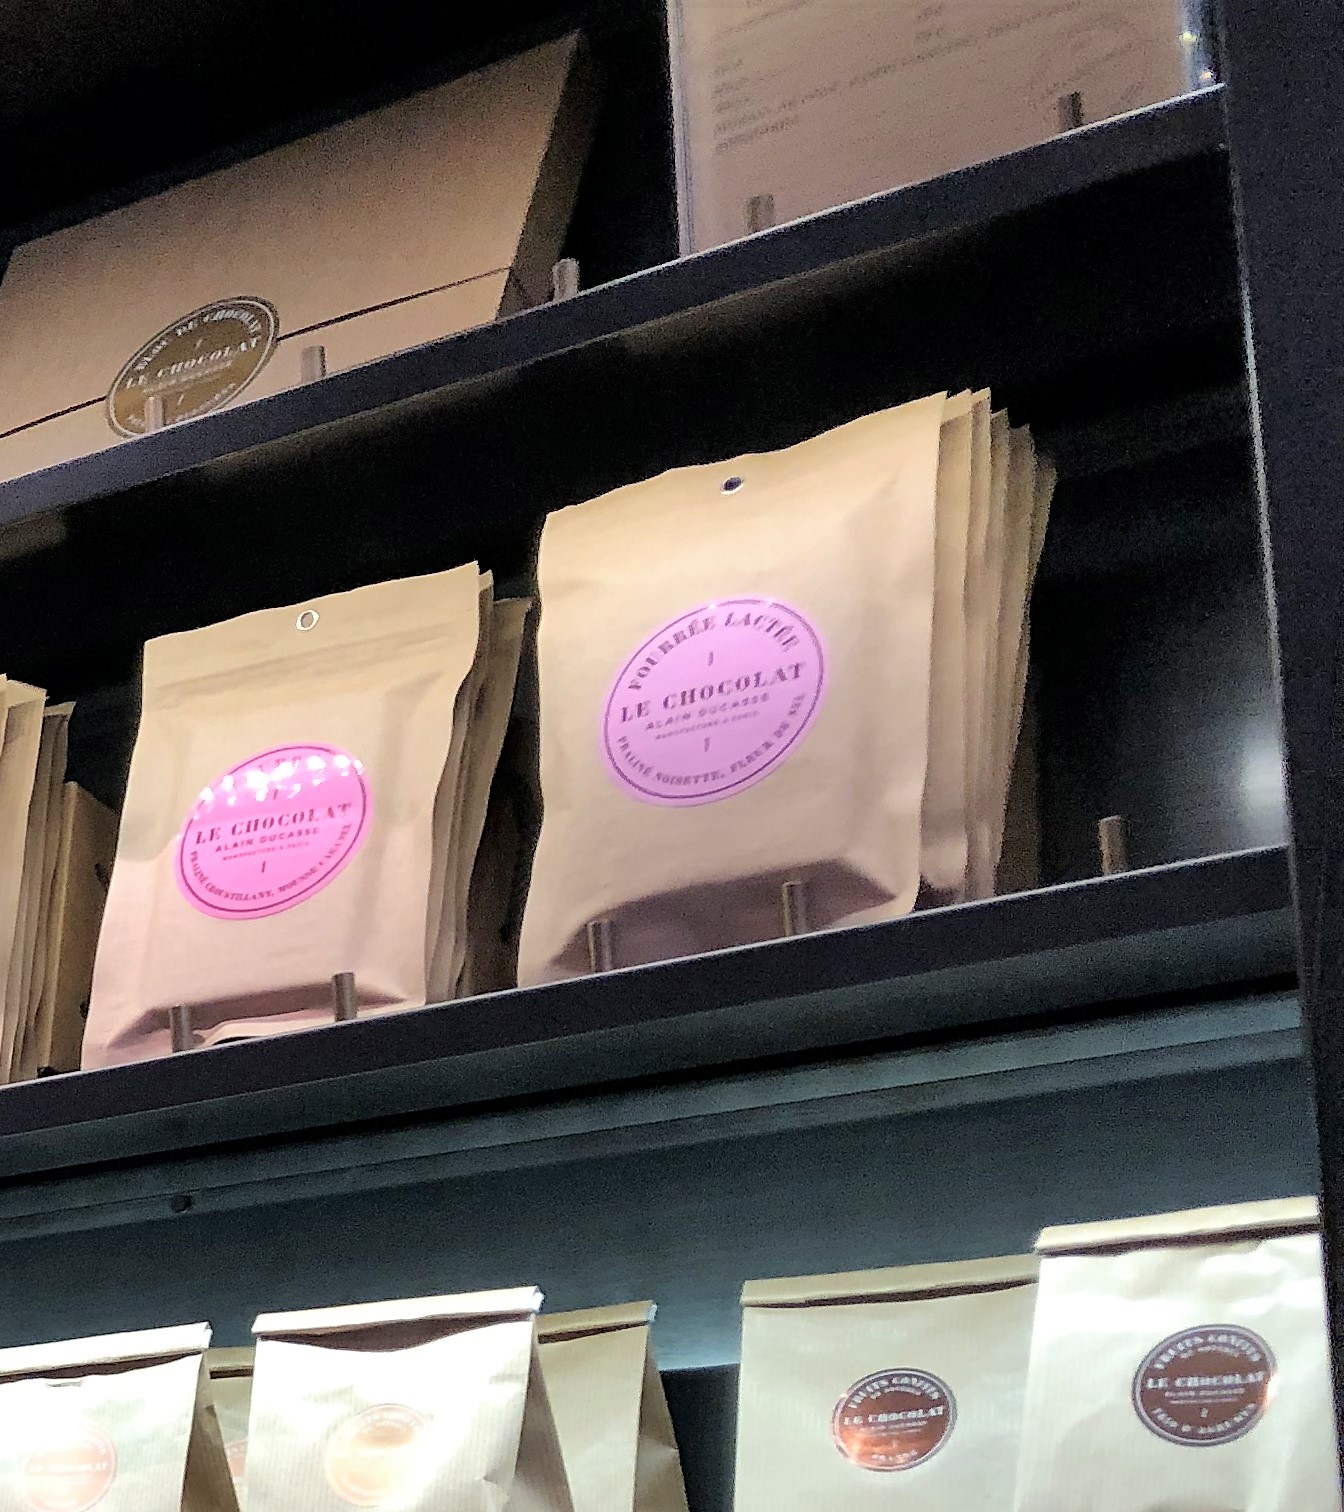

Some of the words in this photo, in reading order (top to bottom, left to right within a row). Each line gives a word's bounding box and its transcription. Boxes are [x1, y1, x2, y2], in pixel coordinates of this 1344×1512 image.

[156, 335, 261, 378] CHOCOLAT
[627, 615, 716, 691] FOURRÉE
[724, 611, 800, 653] LACTÉE
[621, 700, 651, 723] LE
[662, 661, 807, 711] CHOCOLAT
[646, 712, 691, 731] ALAIN
[698, 692, 770, 718] DUCASSE
[194, 826, 222, 846] LE
[230, 801, 353, 837] CHOCOLAT
[215, 838, 254, 853] ALAIN
[258, 826, 320, 844] DUCASSE
[1146, 1377, 1168, 1390] LE
[1174, 1370, 1265, 1388] CHOCOLAT
[843, 1415, 863, 1426] LE
[867, 1405, 945, 1424] CHOCOLAT
